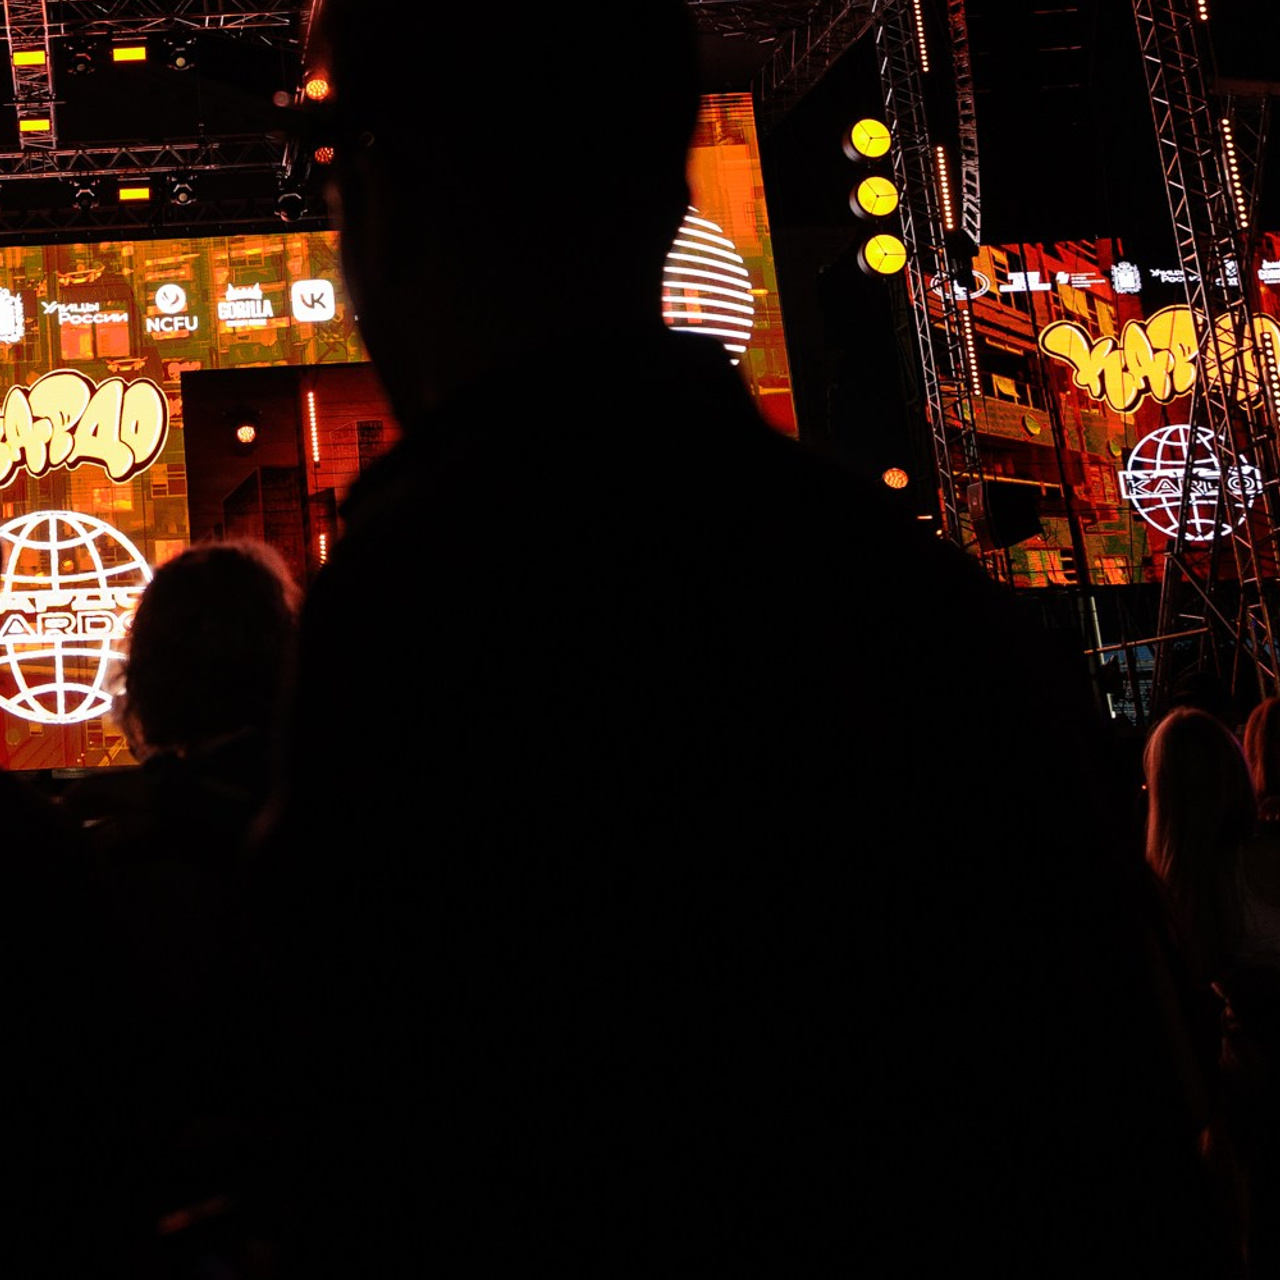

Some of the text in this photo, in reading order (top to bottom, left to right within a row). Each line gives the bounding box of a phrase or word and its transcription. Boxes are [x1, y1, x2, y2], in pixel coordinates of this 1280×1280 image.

[217, 299, 274, 320] GORILLA
[58, 313, 129, 325] России
[146, 316, 198, 333] NCFU
